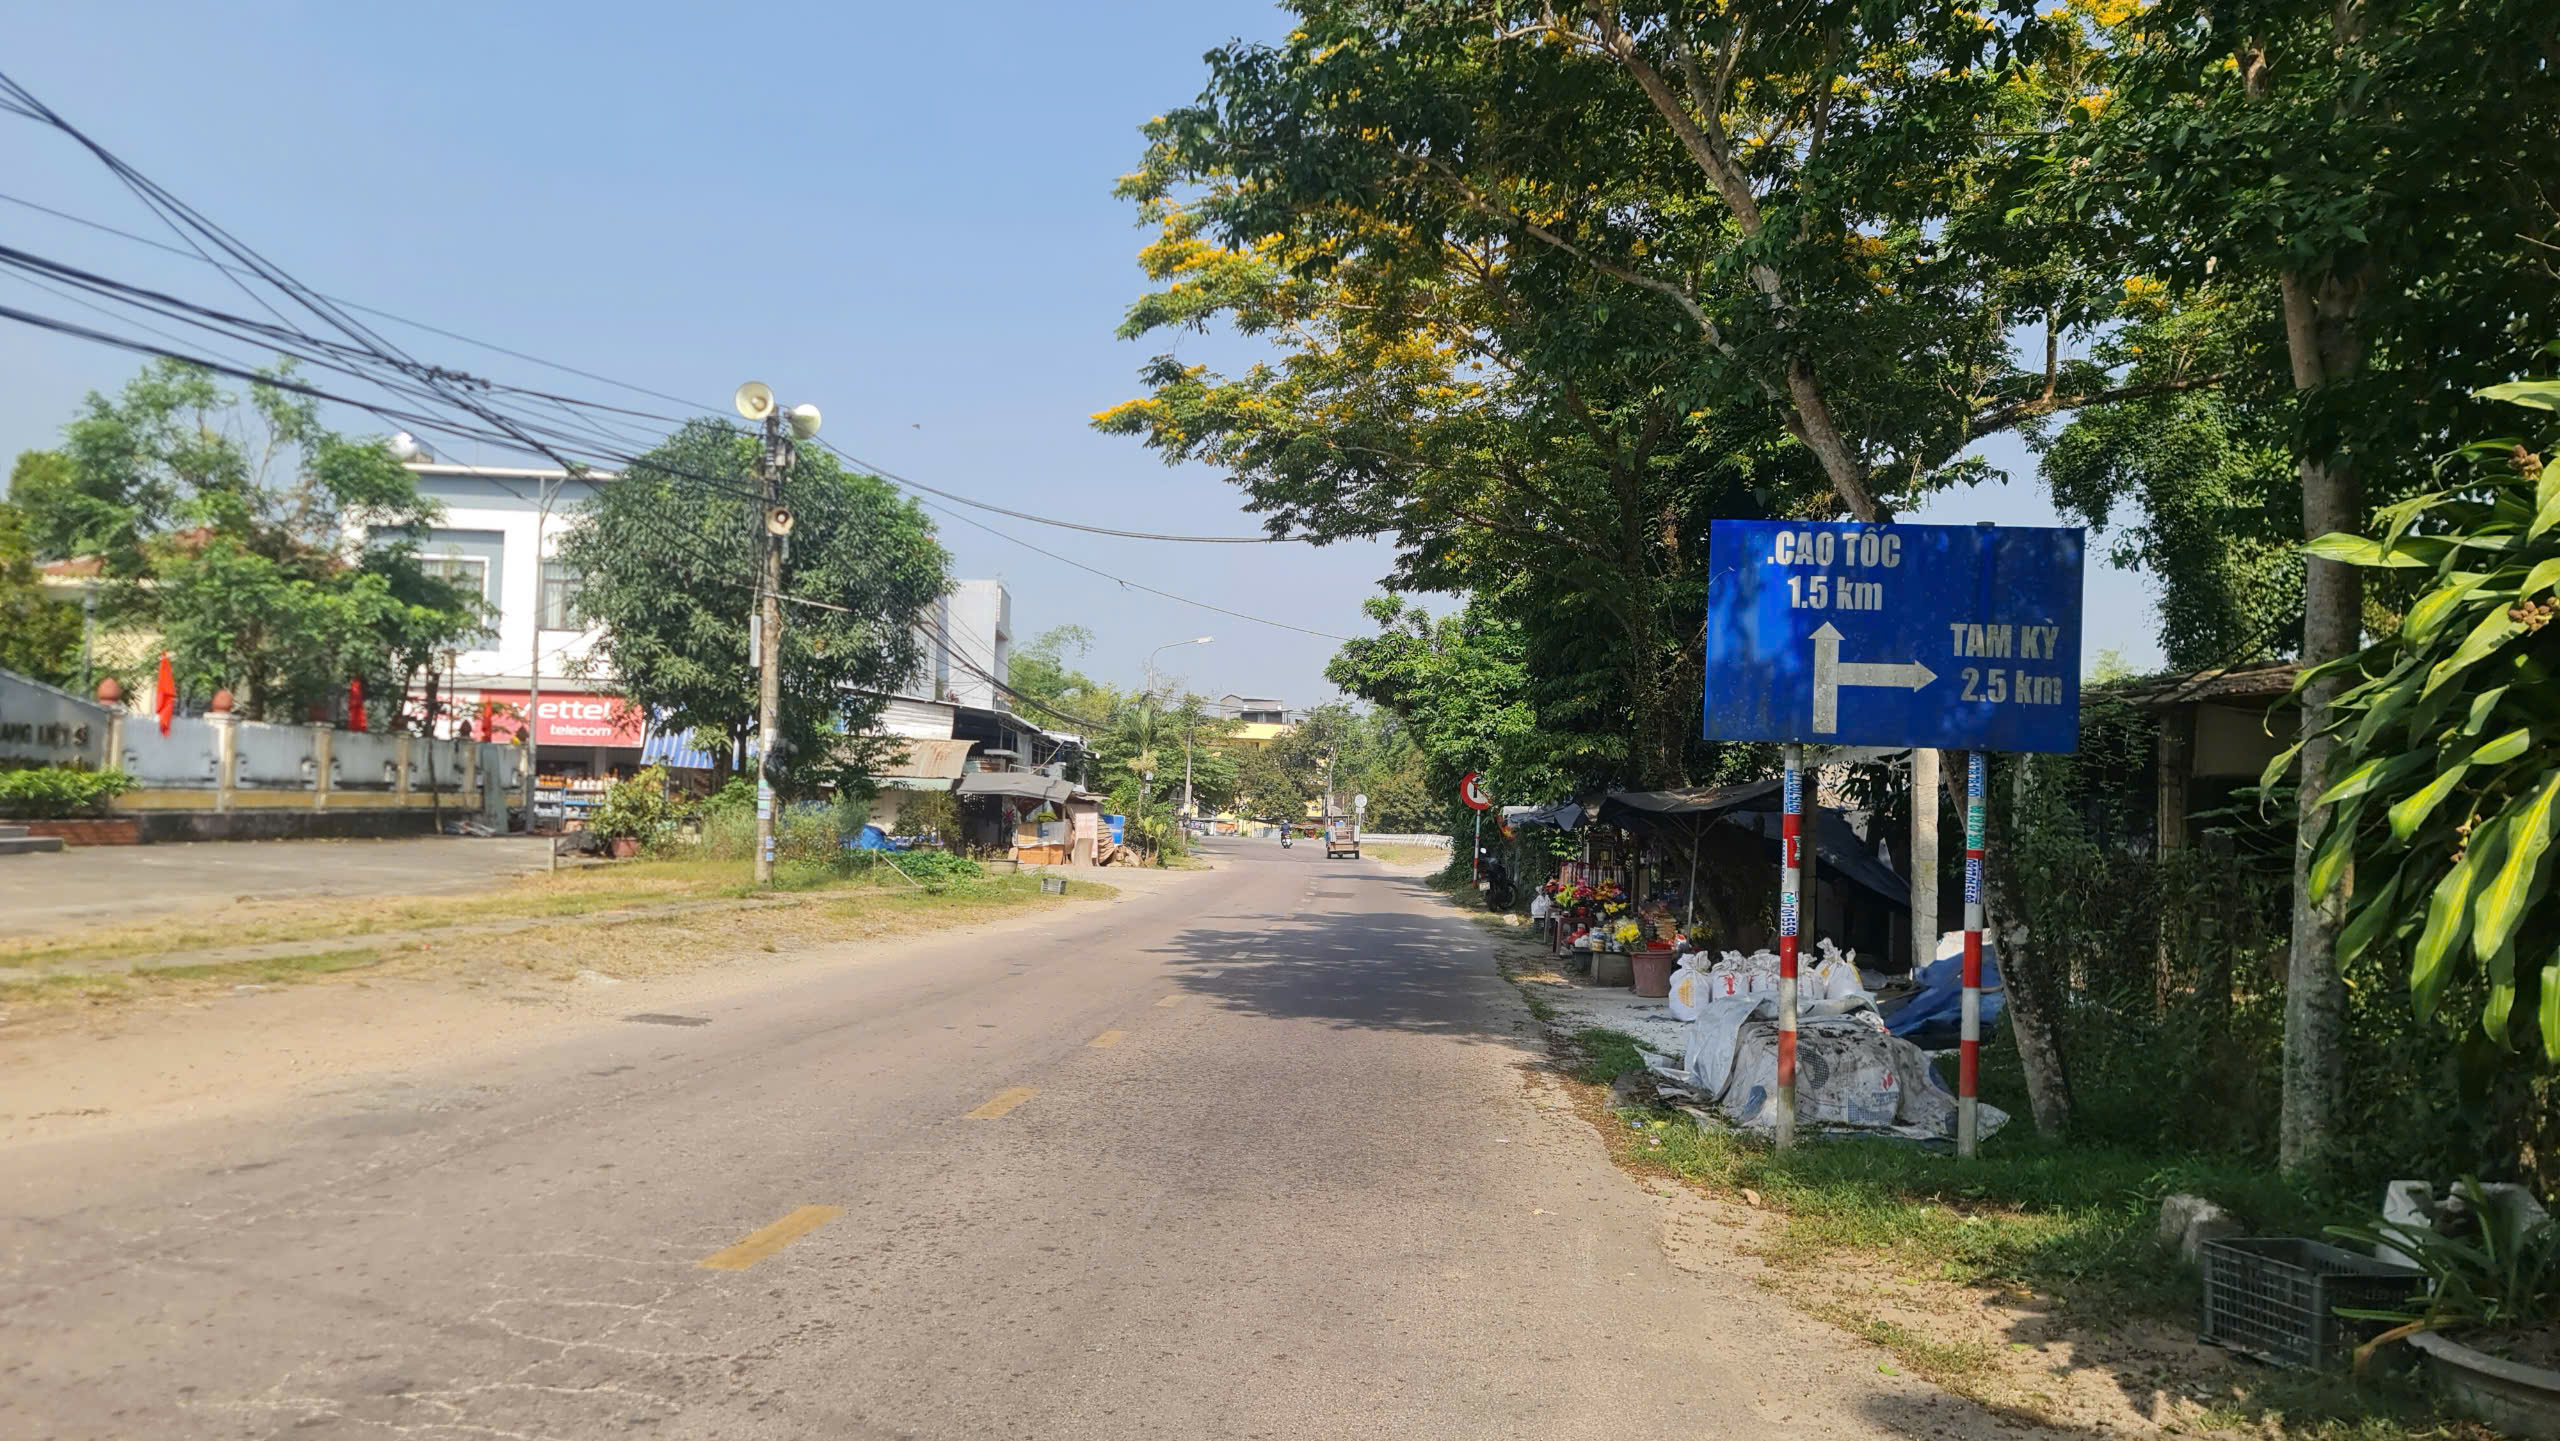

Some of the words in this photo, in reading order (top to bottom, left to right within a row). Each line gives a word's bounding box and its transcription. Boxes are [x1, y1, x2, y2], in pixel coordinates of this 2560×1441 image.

[1842, 524, 1901, 568] TỐC
[1787, 575, 1829, 609] 1.5
[1836, 576, 1883, 611] km
[1949, 623, 2013, 658] TAM
[2020, 617, 2060, 660] KỲ
[1960, 667, 2007, 703] 2.5
[2015, 669, 2063, 705] km
[511, 700, 612, 720] vettel
[549, 723, 612, 737] telecom
